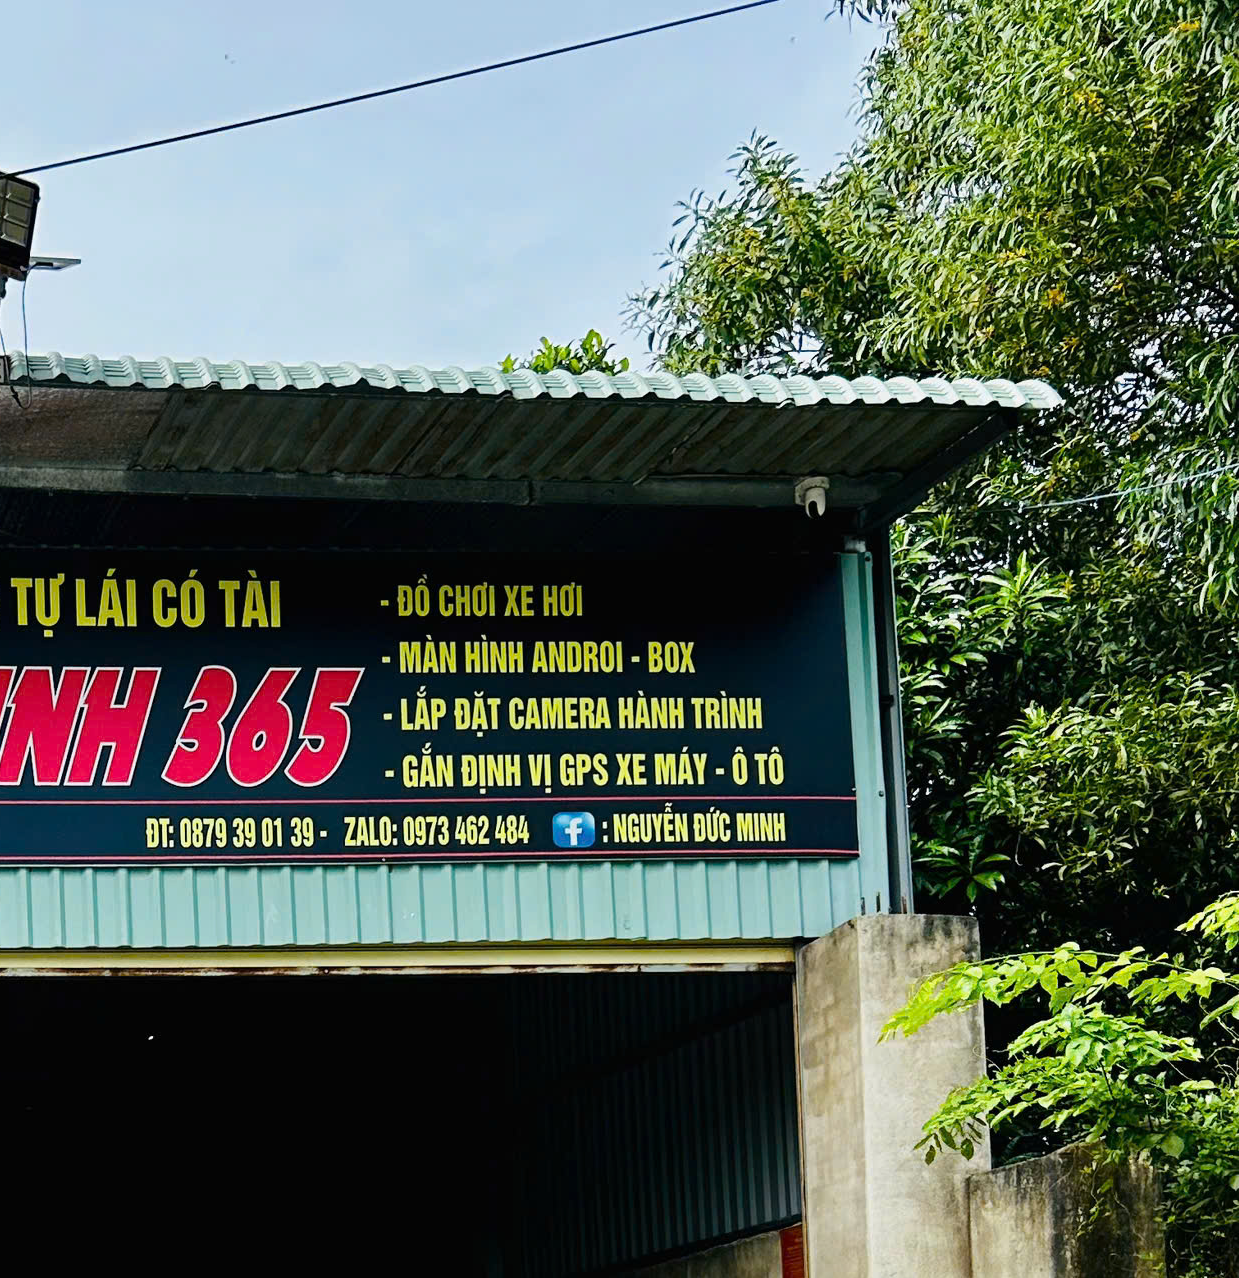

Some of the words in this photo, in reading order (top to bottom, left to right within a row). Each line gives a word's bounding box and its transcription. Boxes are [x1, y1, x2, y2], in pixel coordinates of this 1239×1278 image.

[10, 572, 65, 638] TỰ
[75, 570, 137, 628] LÁI
[152, 570, 209, 628] CÓ
[219, 570, 281, 628] TÀI
[397, 574, 431, 617] ĐỒ
[439, 582, 496, 616] CHƠI
[503, 584, 535, 616] XE
[543, 582, 583, 616] HƠI
[399, 634, 457, 674] MÀN
[464, 634, 523, 674] HÌNH
[531, 640, 623, 673] ANDROI
[647, 641, 695, 674] BOX
[161, 664, 365, 787] 365
[400, 686, 447, 730] LẮP
[453, 690, 501, 738] ĐẶT
[508, 696, 611, 730] CAMERA
[617, 690, 684, 729] HÀNH
[691, 690, 763, 729] TRÌNH
[401, 742, 453, 788] GẮN
[461, 752, 521, 794] ĐỊNH
[528, 753, 552, 794] VỊ
[559, 752, 609, 787] GPS
[615, 752, 647, 786] XE
[654, 746, 707, 786] MÁY
[731, 746, 749, 786] Ô
[753, 746, 784, 786] TÔ
[145, 818, 175, 848] ĐT:
[179, 817, 227, 848] 0879
[231, 816, 257, 848] 39
[261, 816, 283, 848] 01
[290, 816, 315, 848] 39
[343, 815, 398, 846] ZALO:
[403, 815, 450, 846] 0973
[455, 815, 490, 845] 462
[495, 814, 529, 844] 484
[613, 802, 689, 844] NGUYỄN
[693, 806, 731, 842] ĐỨC
[736, 812, 786, 842] MINH
